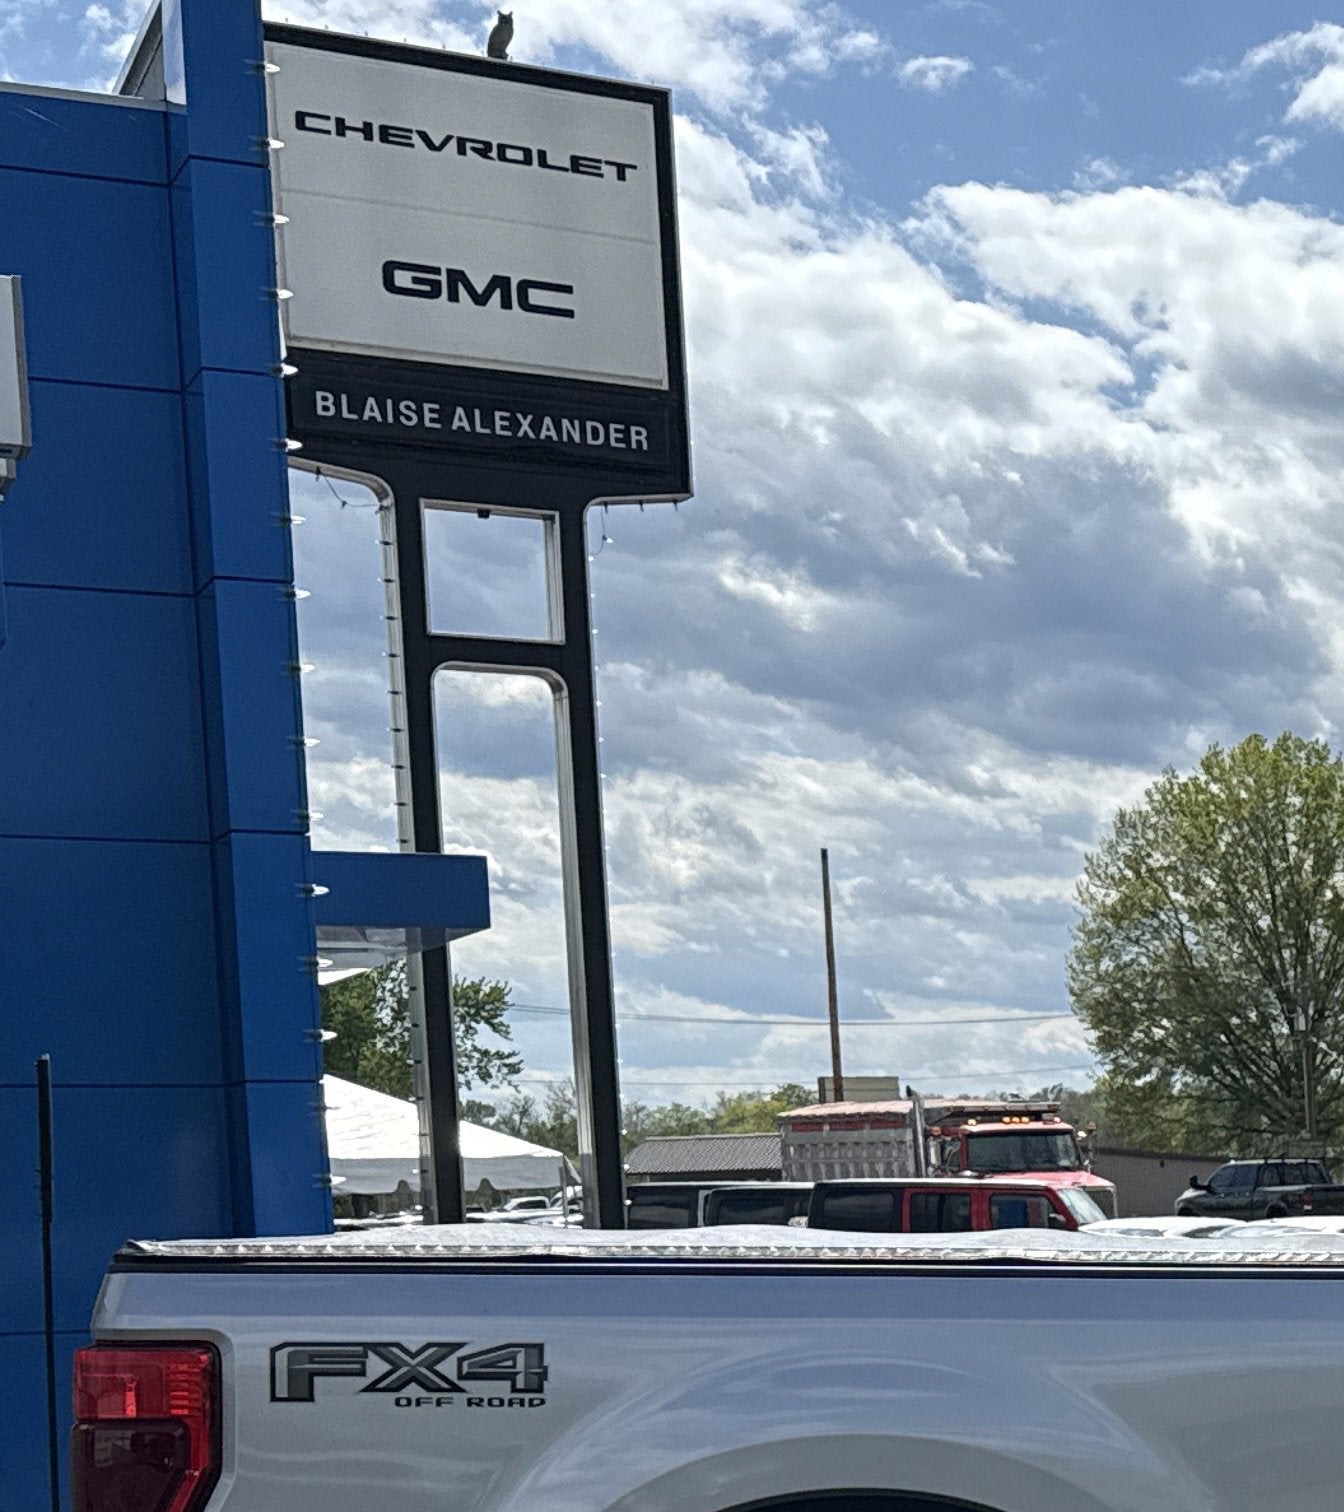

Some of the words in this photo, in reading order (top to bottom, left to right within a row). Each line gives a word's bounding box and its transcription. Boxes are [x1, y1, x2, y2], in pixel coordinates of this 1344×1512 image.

[294, 109, 638, 182] CHEVROLET
[382, 260, 575, 319] GMC
[315, 391, 441, 428] BLAISE
[452, 406, 648, 451] ALEXANDER
[270, 1342, 547, 1402] FX4
[395, 1397, 453, 1407] OFF
[467, 1397, 546, 1408] ROAD
